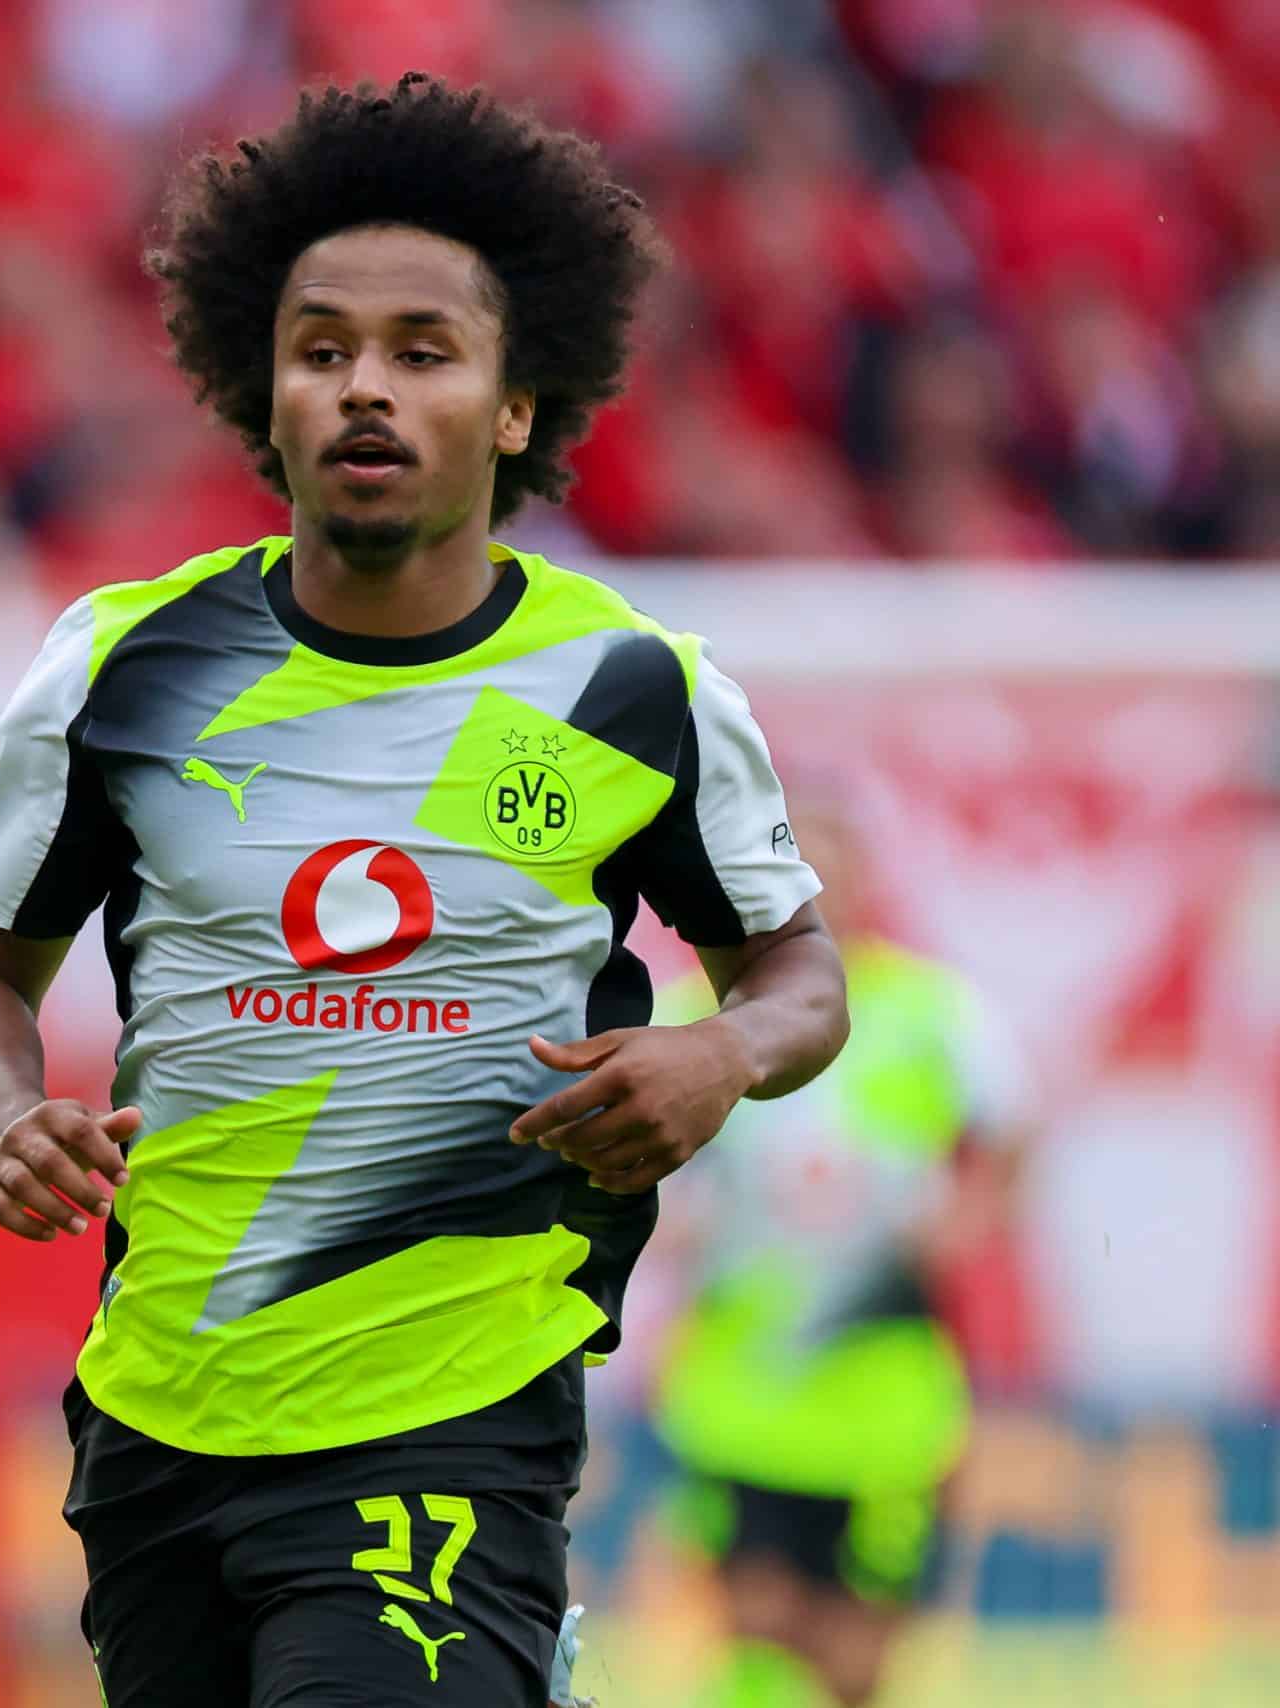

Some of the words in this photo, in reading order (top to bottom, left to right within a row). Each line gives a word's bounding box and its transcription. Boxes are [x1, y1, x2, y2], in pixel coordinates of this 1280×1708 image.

[497, 769, 568, 829] BVB
[517, 826, 542, 847] 09
[225, 982, 471, 1034] vodafone
[351, 1493, 478, 1607] 27
